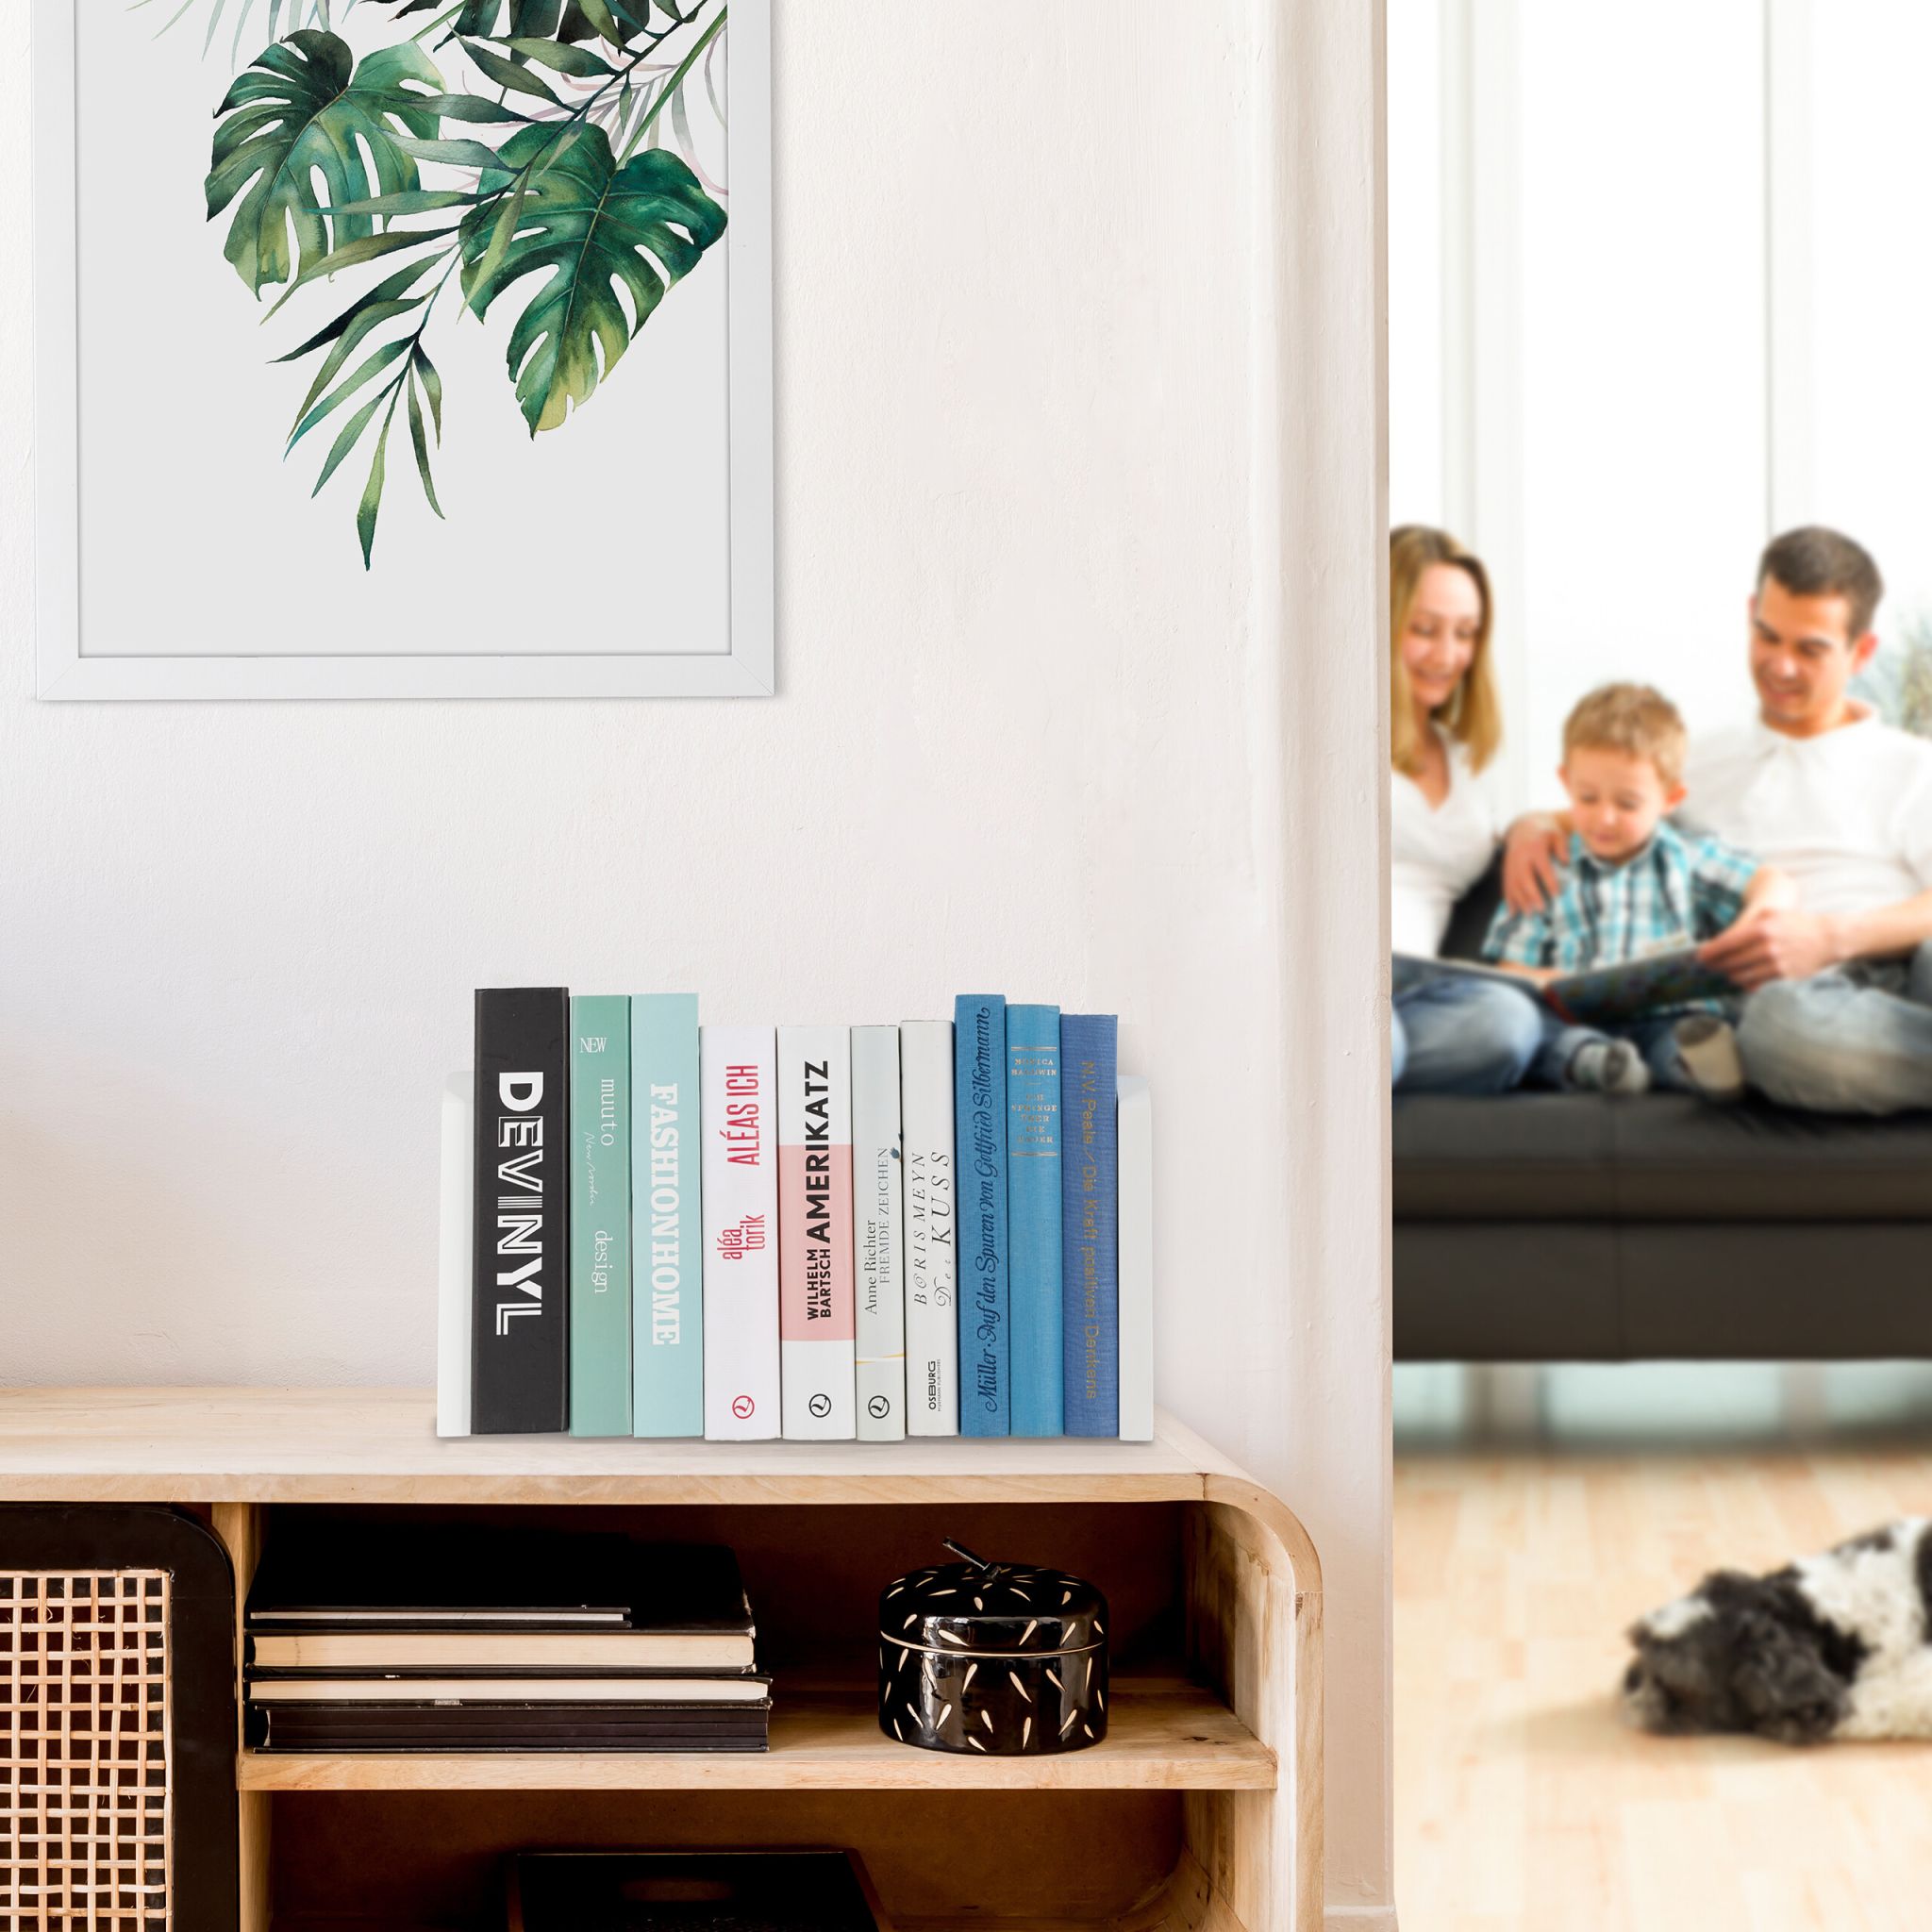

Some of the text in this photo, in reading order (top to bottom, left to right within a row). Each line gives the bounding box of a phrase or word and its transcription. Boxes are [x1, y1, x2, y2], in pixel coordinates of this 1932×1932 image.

[580, 1037, 608, 1054] NEW
[973, 1007, 992, 1109] Silbermann
[601, 1078, 618, 1146] muuto
[721, 1065, 760, 1166] ALÉAS ICH
[974, 1110, 998, 1178] Gottfried
[805, 1060, 831, 1244] AMERIKATZ
[496, 1071, 544, 1336] DEVINYL
[651, 1083, 680, 1345] FASHIONHOME
[741, 1214, 765, 1250] torik
[878, 1148, 891, 1284] FREMDE ZEICHEN
[912, 1153, 927, 1306] BORIS MEYN
[931, 1151, 951, 1247] KUSS
[592, 1230, 613, 1294] design
[718, 1228, 743, 1259] aléa
[864, 1220, 877, 1315] Anne Richter
[975, 1213, 1000, 1274] Spuren
[808, 1248, 819, 1321] WILHELM
[820, 1248, 832, 1318] BARTSCH
[982, 1276, 996, 1305] den
[928, 1360, 937, 1410] OSBURG
